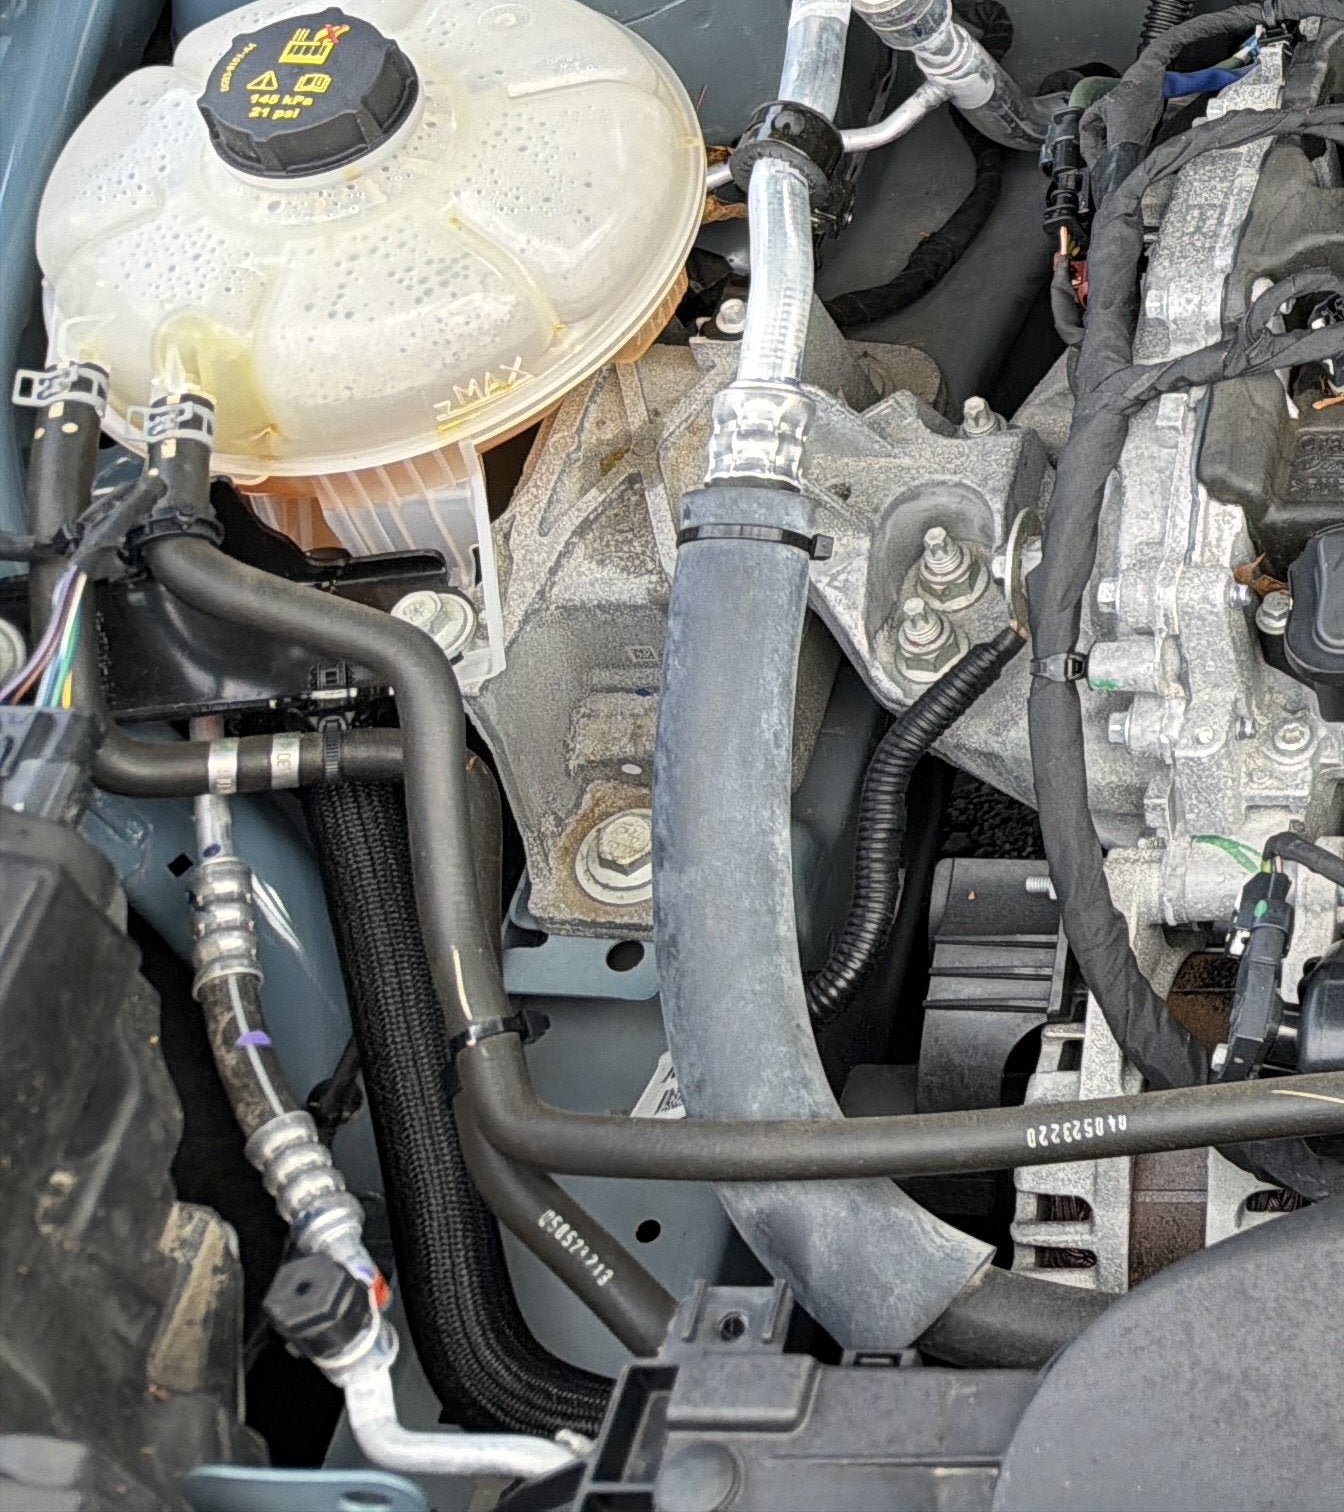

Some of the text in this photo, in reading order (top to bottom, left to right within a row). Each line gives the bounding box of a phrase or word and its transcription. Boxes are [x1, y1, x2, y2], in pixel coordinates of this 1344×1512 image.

[282, 93, 314, 107] kPa
[248, 106, 301, 121] 21 psi
[452, 355, 536, 407] MAX
